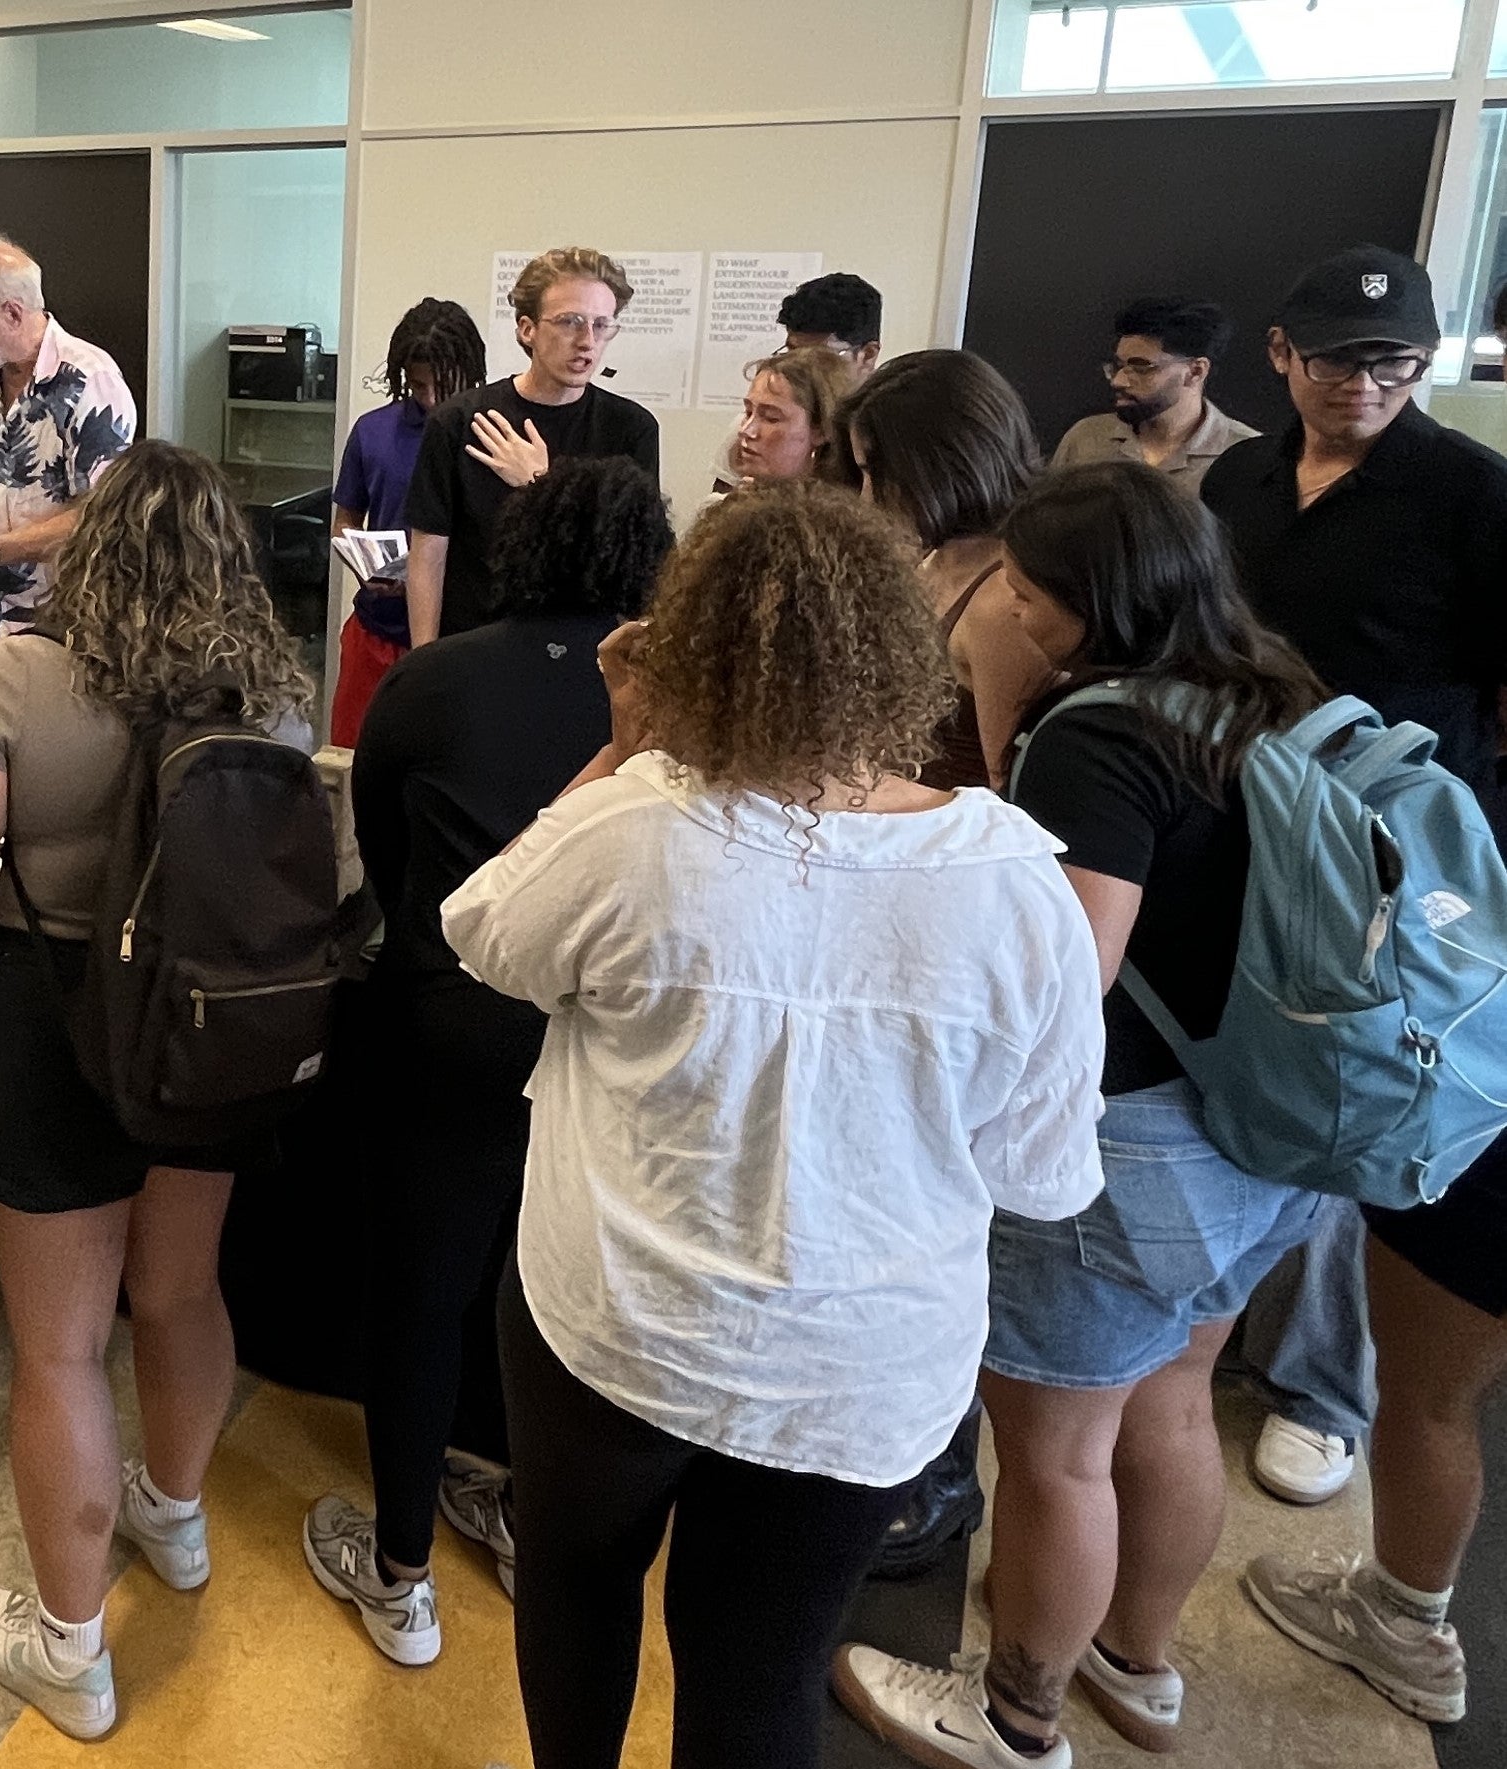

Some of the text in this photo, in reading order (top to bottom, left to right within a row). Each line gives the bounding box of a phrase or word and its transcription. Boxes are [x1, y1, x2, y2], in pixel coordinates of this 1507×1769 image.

[716, 259, 759, 267] TO WHAT
[714, 270, 751, 278] EXTENT
[340, 1544, 357, 1577] N
